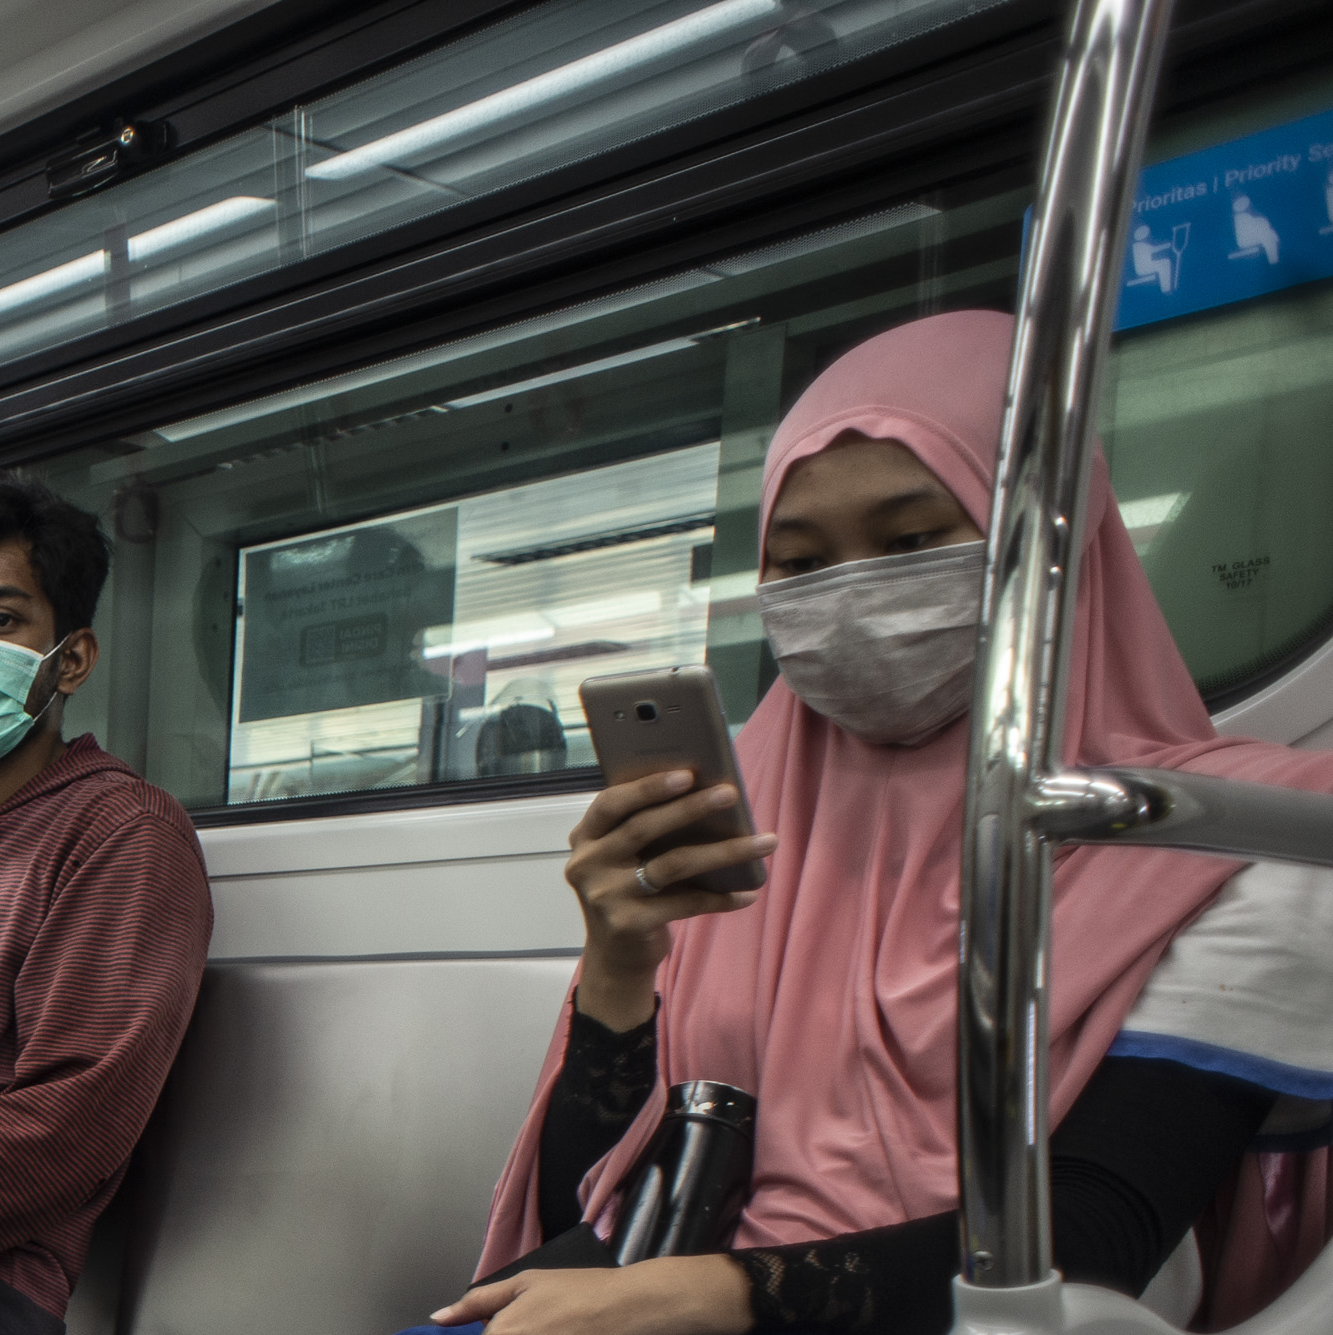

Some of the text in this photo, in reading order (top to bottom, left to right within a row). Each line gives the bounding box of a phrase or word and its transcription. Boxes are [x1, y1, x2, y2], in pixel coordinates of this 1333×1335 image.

[1225, 154, 1301, 187] Priority
[1232, 556, 1270, 570] GLASS
[1219, 568, 1260, 581] SAFETY
